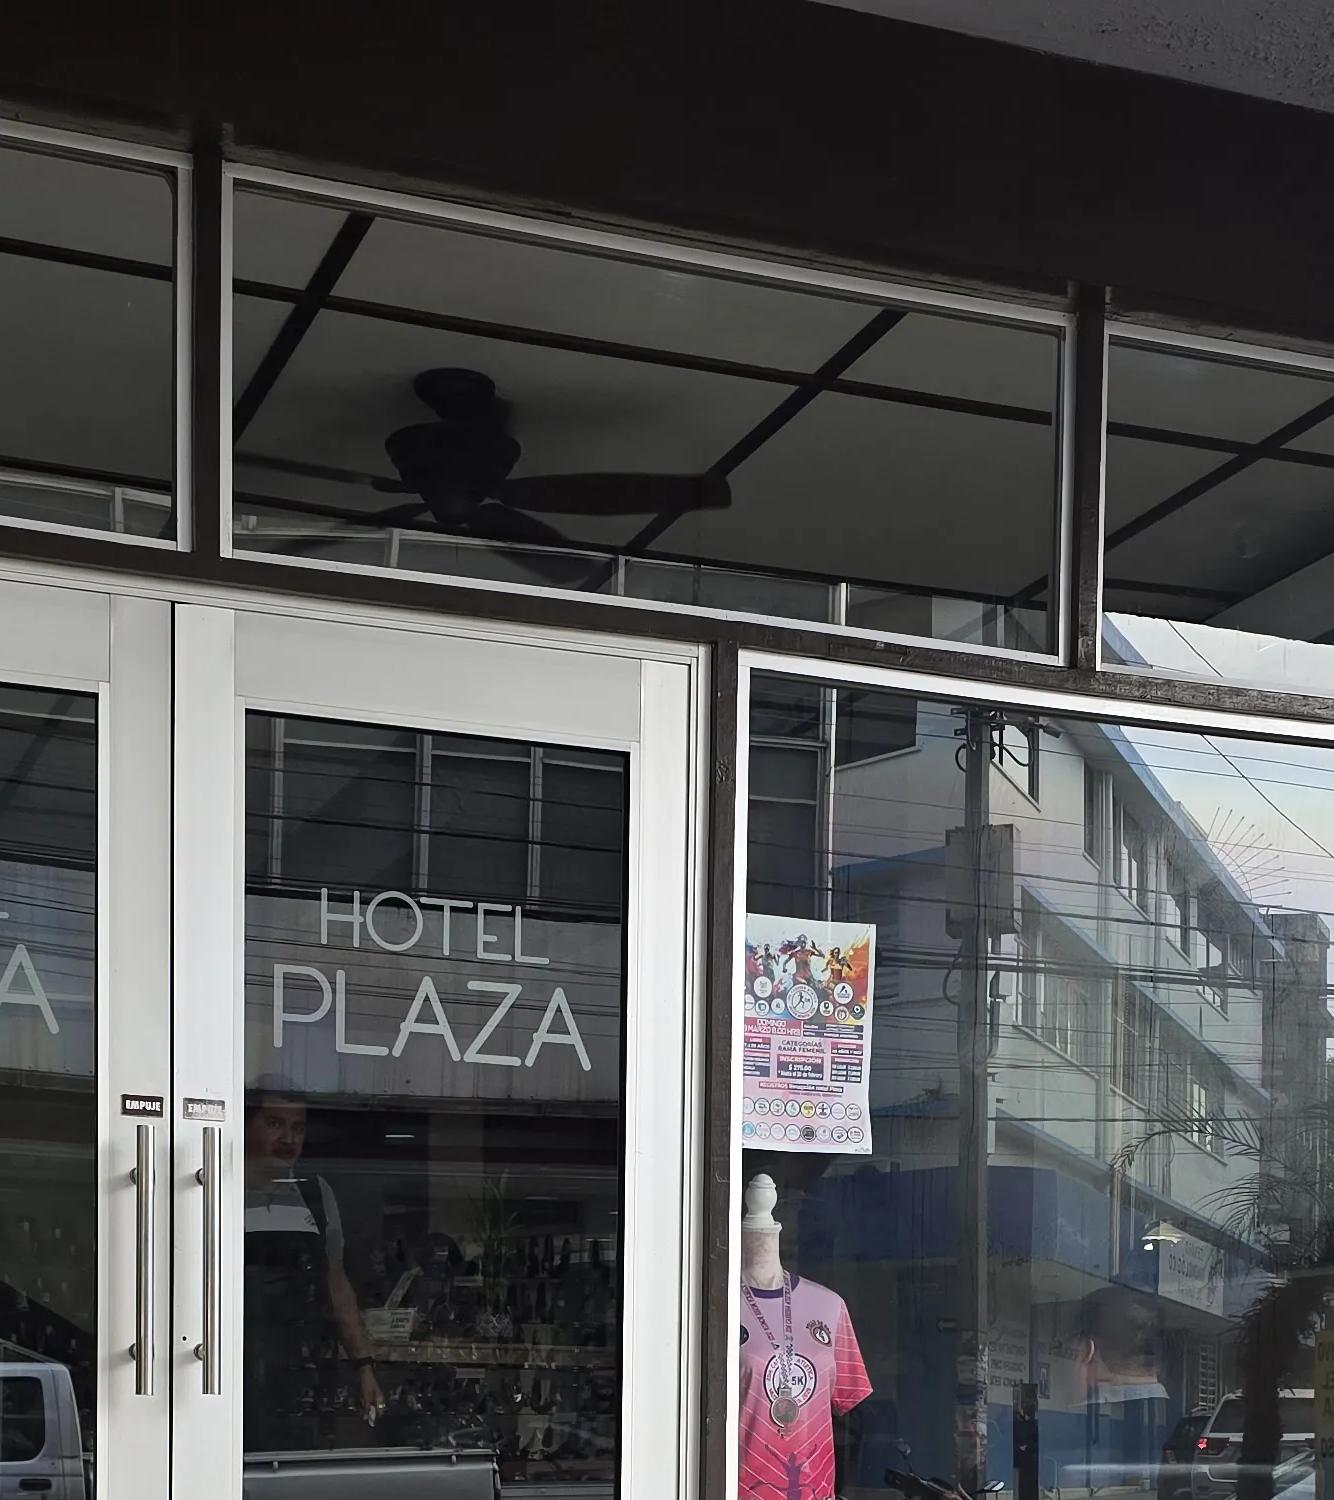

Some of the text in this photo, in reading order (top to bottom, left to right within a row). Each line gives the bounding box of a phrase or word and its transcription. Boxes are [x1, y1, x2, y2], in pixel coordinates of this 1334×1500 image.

[319, 887, 550, 965] HOTEL
[272, 963, 592, 1072] PLAZA
[757, 1018, 787, 1028] DOMINGO
[748, 1024, 771, 1034] MARZO
[782, 1039, 823, 1048] CATEGORÍAS
[778, 1045, 797, 1053] RAMA
[798, 1046, 827, 1055] FEMENIL
[779, 1054, 822, 1065] INSCRIPCIÓN
[125, 1099, 161, 1112] EMPUJE
[791, 1375, 804, 1386] 5K
